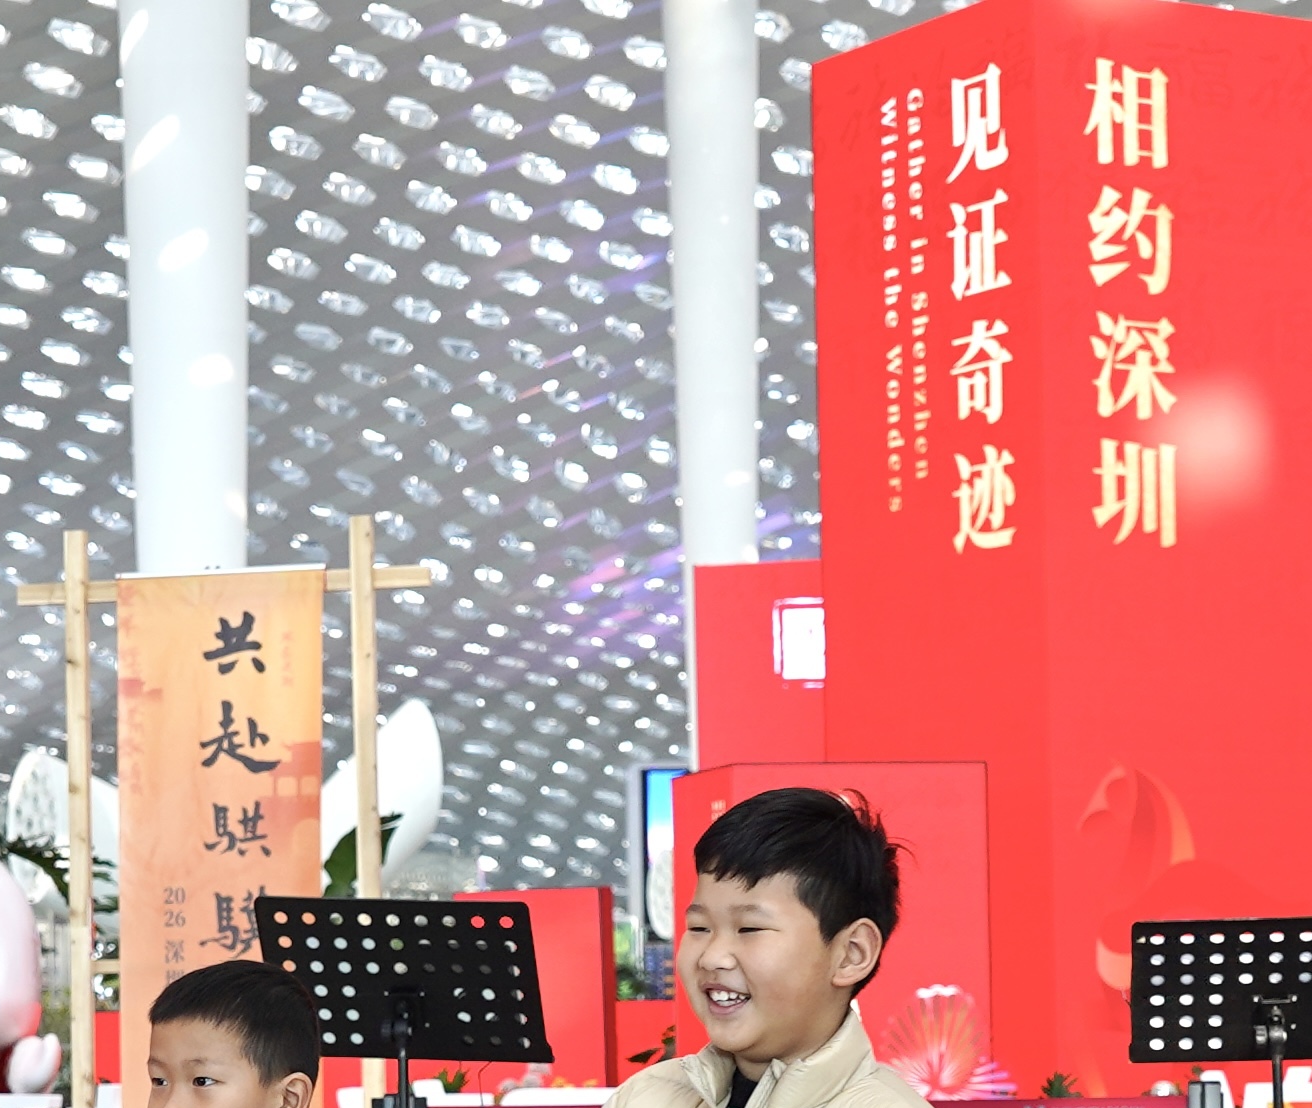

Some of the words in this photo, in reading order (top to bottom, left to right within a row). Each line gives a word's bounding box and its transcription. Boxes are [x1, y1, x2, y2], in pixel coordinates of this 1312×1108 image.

[880, 97, 897, 252] Witness
[906, 87, 926, 221] Gather
[883, 267, 900, 328] the
[909, 237, 929, 275] in
[945, 62, 1017, 555] 见证奇迹
[1083, 57, 1178, 548] 相约深圳
[885, 346, 903, 513] Wonders
[911, 291, 931, 480] Shenzhen
